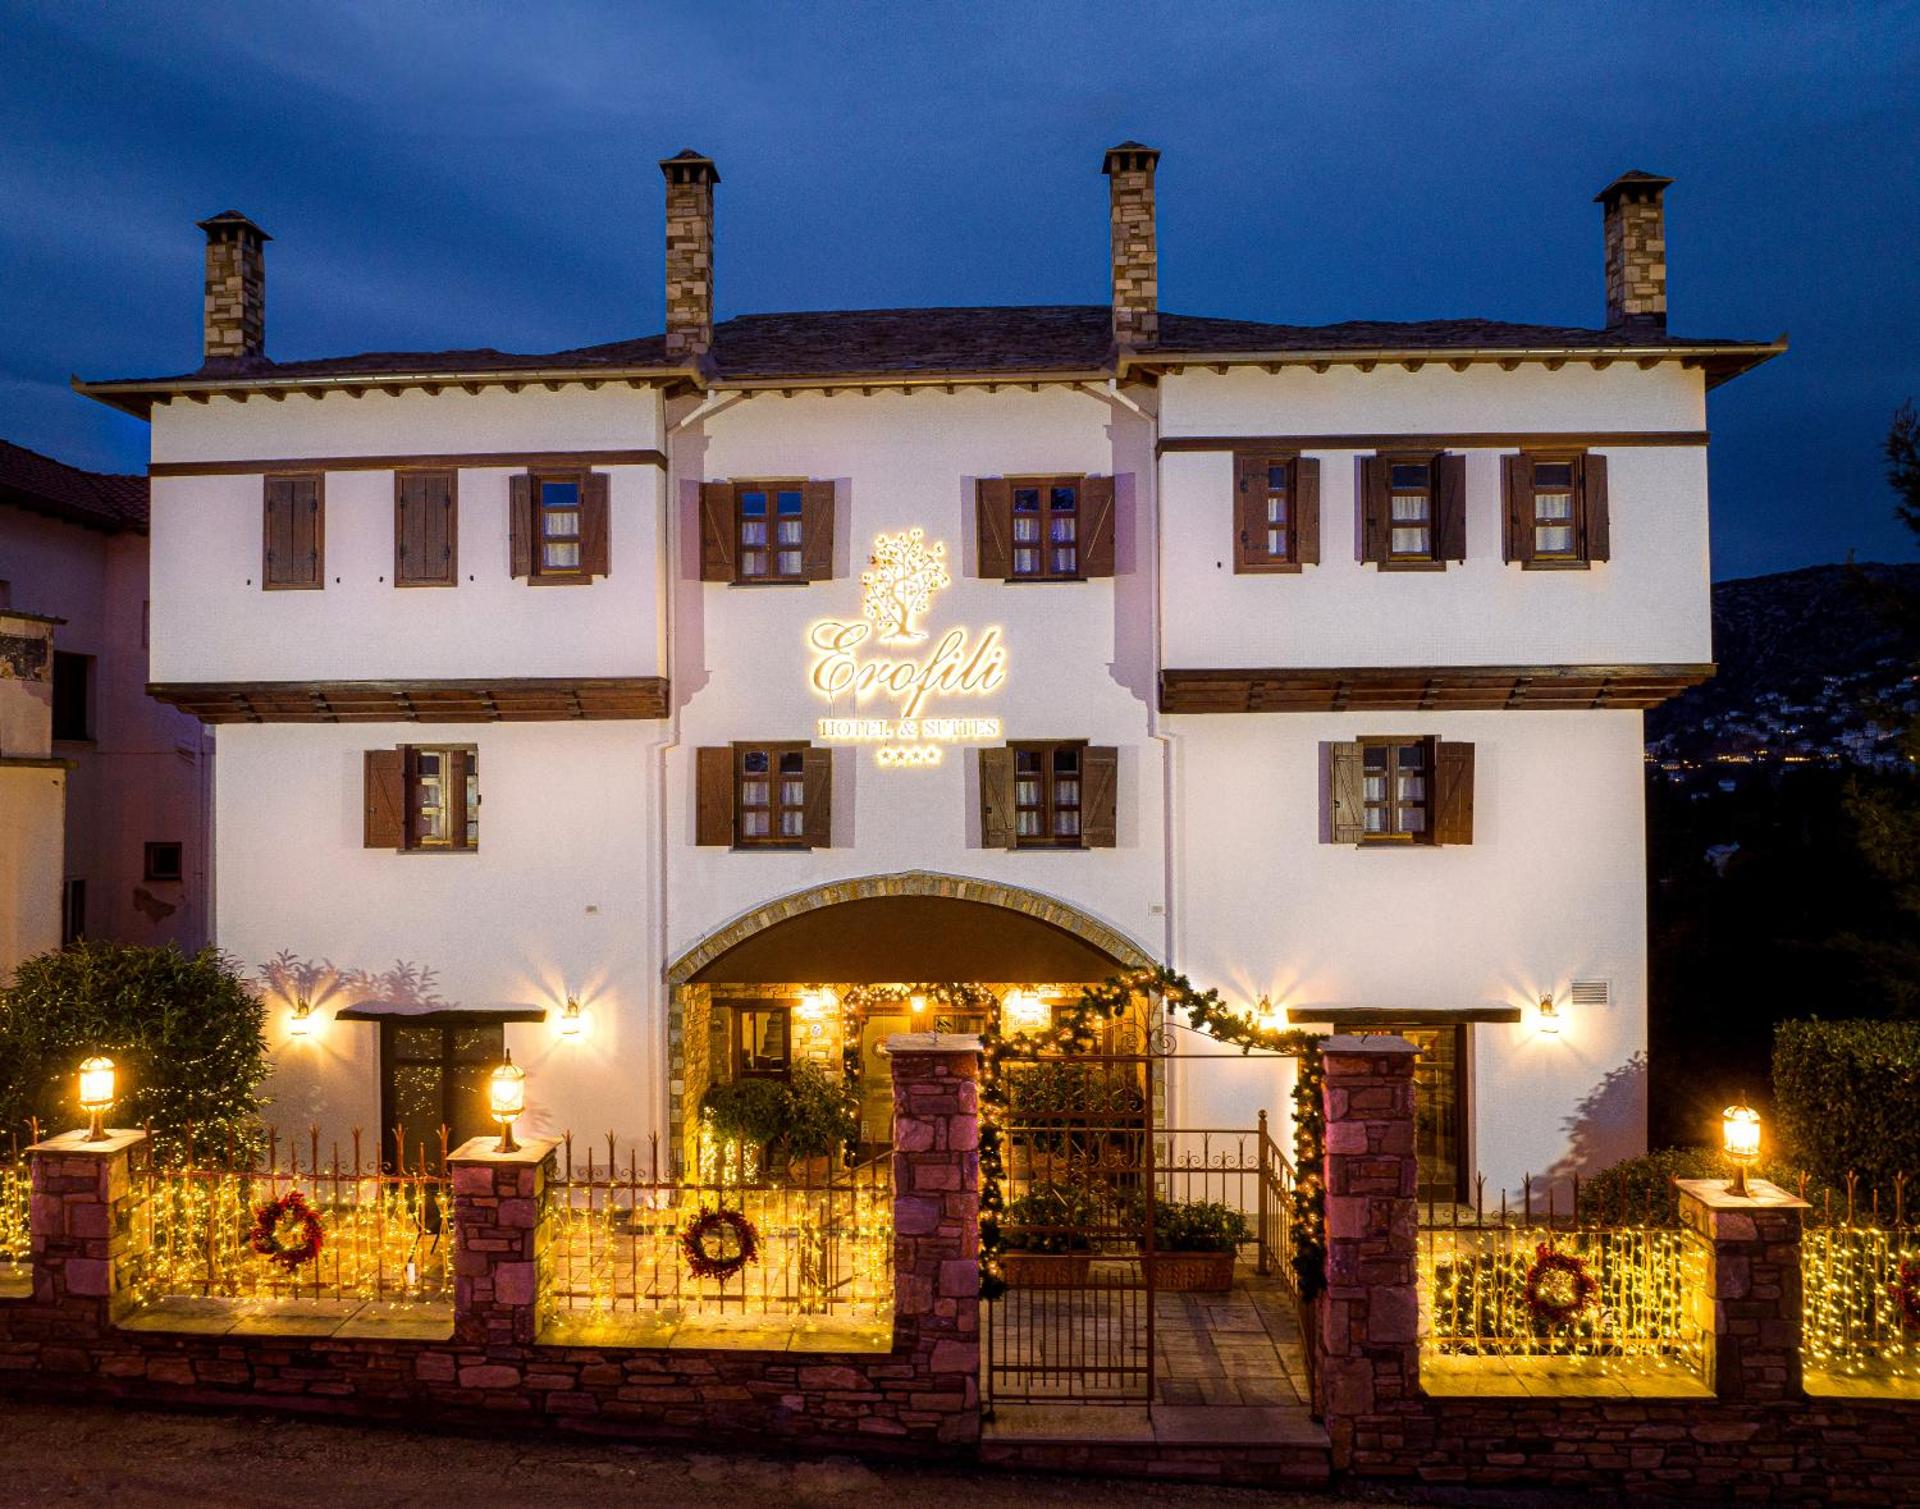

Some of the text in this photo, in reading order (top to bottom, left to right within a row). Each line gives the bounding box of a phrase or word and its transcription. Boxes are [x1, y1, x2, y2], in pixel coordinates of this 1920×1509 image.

[811, 622, 1004, 718] Erofili
[822, 719, 998, 737] HOTEL & SUITES
